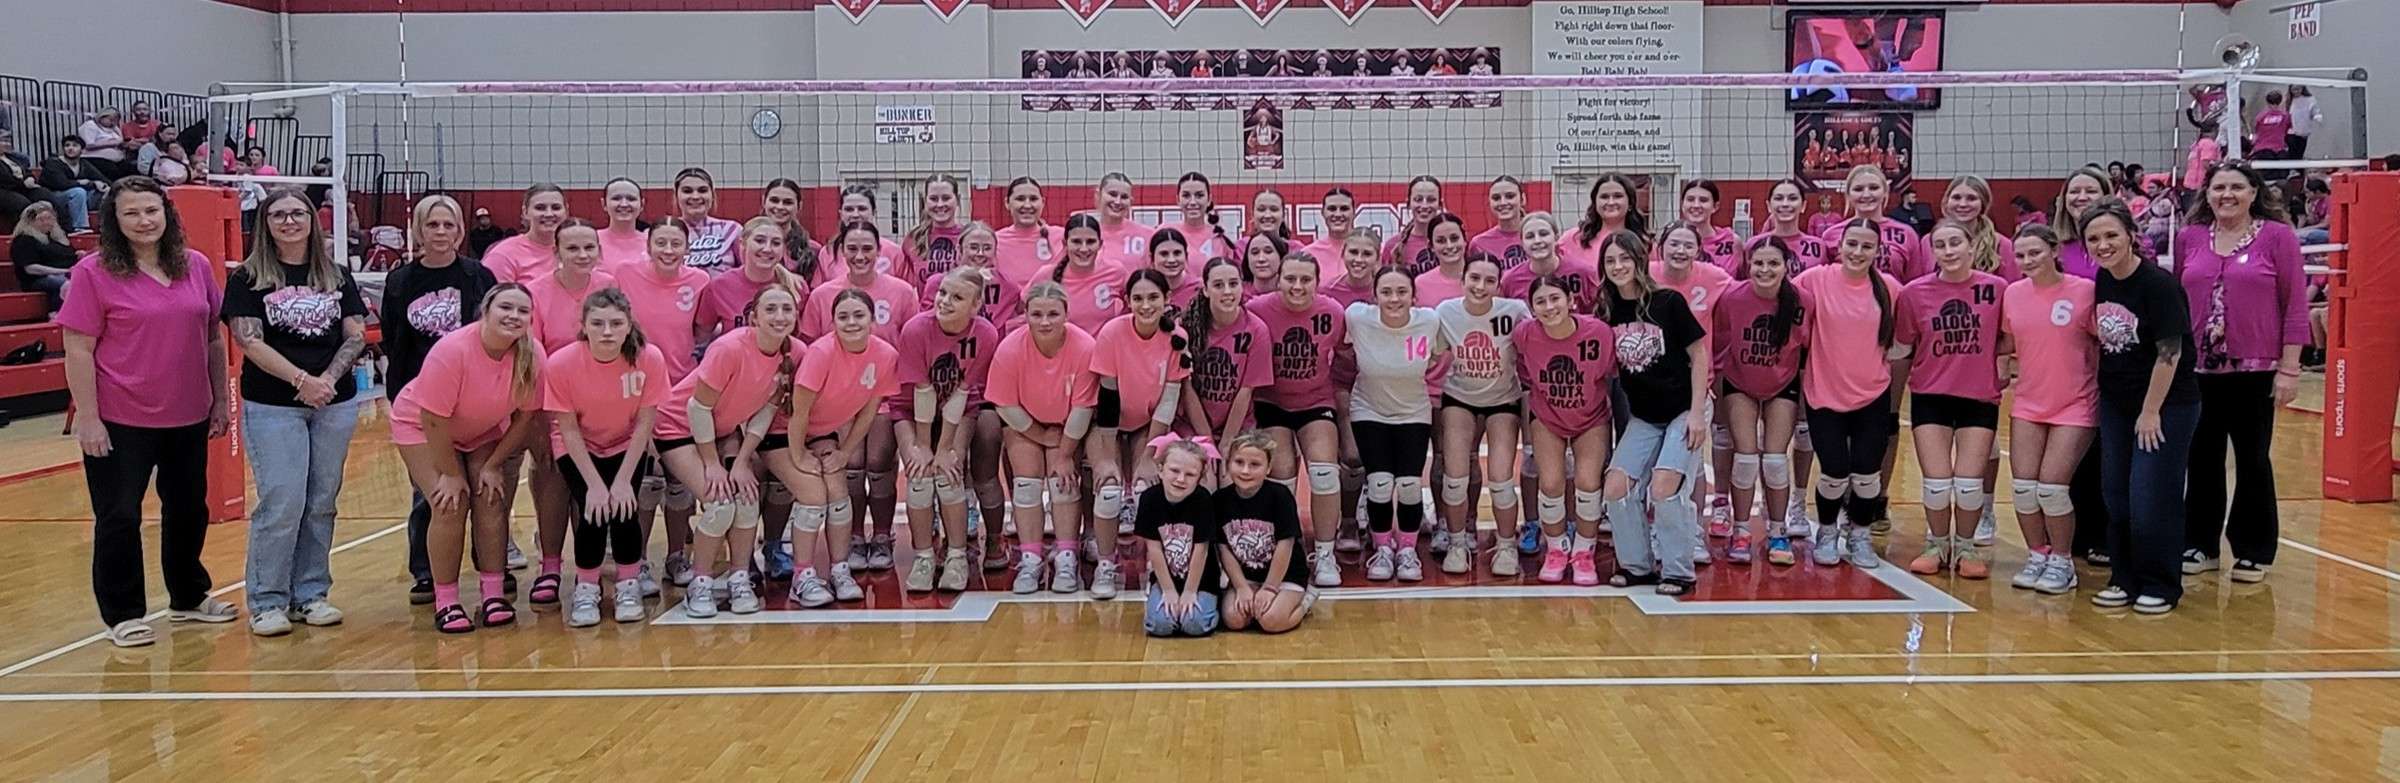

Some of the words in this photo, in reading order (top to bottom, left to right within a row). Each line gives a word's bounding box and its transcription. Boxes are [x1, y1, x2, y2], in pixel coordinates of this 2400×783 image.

[1560, 6, 1575, 15] Go,
[1578, 6, 1611, 16] Hilltop
[1613, 6, 1636, 16] High
[2294, 4, 2315, 20] PEP
[1555, 22, 1579, 32] Fight
[1581, 22, 1602, 32] right
[1605, 22, 1628, 30] down
[1631, 22, 1648, 30] that
[2291, 21, 2316, 39] BAND
[1566, 37, 1588, 45] With
[1608, 37, 1633, 45] colors
[1548, 52, 1562, 60] We
[1565, 52, 1581, 60] will
[1584, 52, 1607, 60] cheer
[1609, 54, 1625, 63] you
[1645, 52, 1660, 60] and
[1578, 98, 1602, 108] Fight
[1604, 98, 1618, 106] for
[1567, 113, 1597, 123] Spread
[1600, 113, 1622, 121] forth
[1624, 113, 1637, 121] the
[1640, 113, 1661, 121] fame
[1568, 128, 1579, 136] Of
[1598, 128, 1615, 136] fair
[1645, 128, 1660, 136] and
[1556, 143, 1571, 152] Go,
[1885, 229, 1905, 244] 15
[1124, 236, 1145, 257] 10
[1715, 241, 1734, 256] 25
[1800, 240, 1821, 258] 20
[928, 261, 951, 273] OUT
[676, 286, 695, 311] 3
[985, 284, 1000, 305] 17
[1690, 286, 1707, 311] 2
[1970, 284, 1996, 305] 14
[874, 300, 890, 325] 6
[2051, 300, 2074, 326] 6
[1310, 313, 1332, 335] 18
[1490, 315, 1513, 337] 10
[1932, 313, 1981, 331] BLOCK
[1233, 332, 1252, 354] 12
[1944, 329, 1971, 343] OUT
[958, 337, 977, 360] 11
[1273, 342, 1319, 357] BLOCK
[1404, 336, 1428, 361] 14
[1457, 346, 1501, 361] BLOCK
[1577, 340, 1600, 361] 13
[1932, 339, 1983, 357] Cancer
[1283, 358, 1308, 370] OUT
[1467, 361, 1491, 371] OUT
[860, 363, 876, 390] 4
[1204, 377, 1229, 391] OUT
[1540, 370, 1585, 385] BLOCK
[2336, 359, 2346, 393] sports
[621, 371, 646, 399] 10
[1549, 385, 1574, 398] OUT
